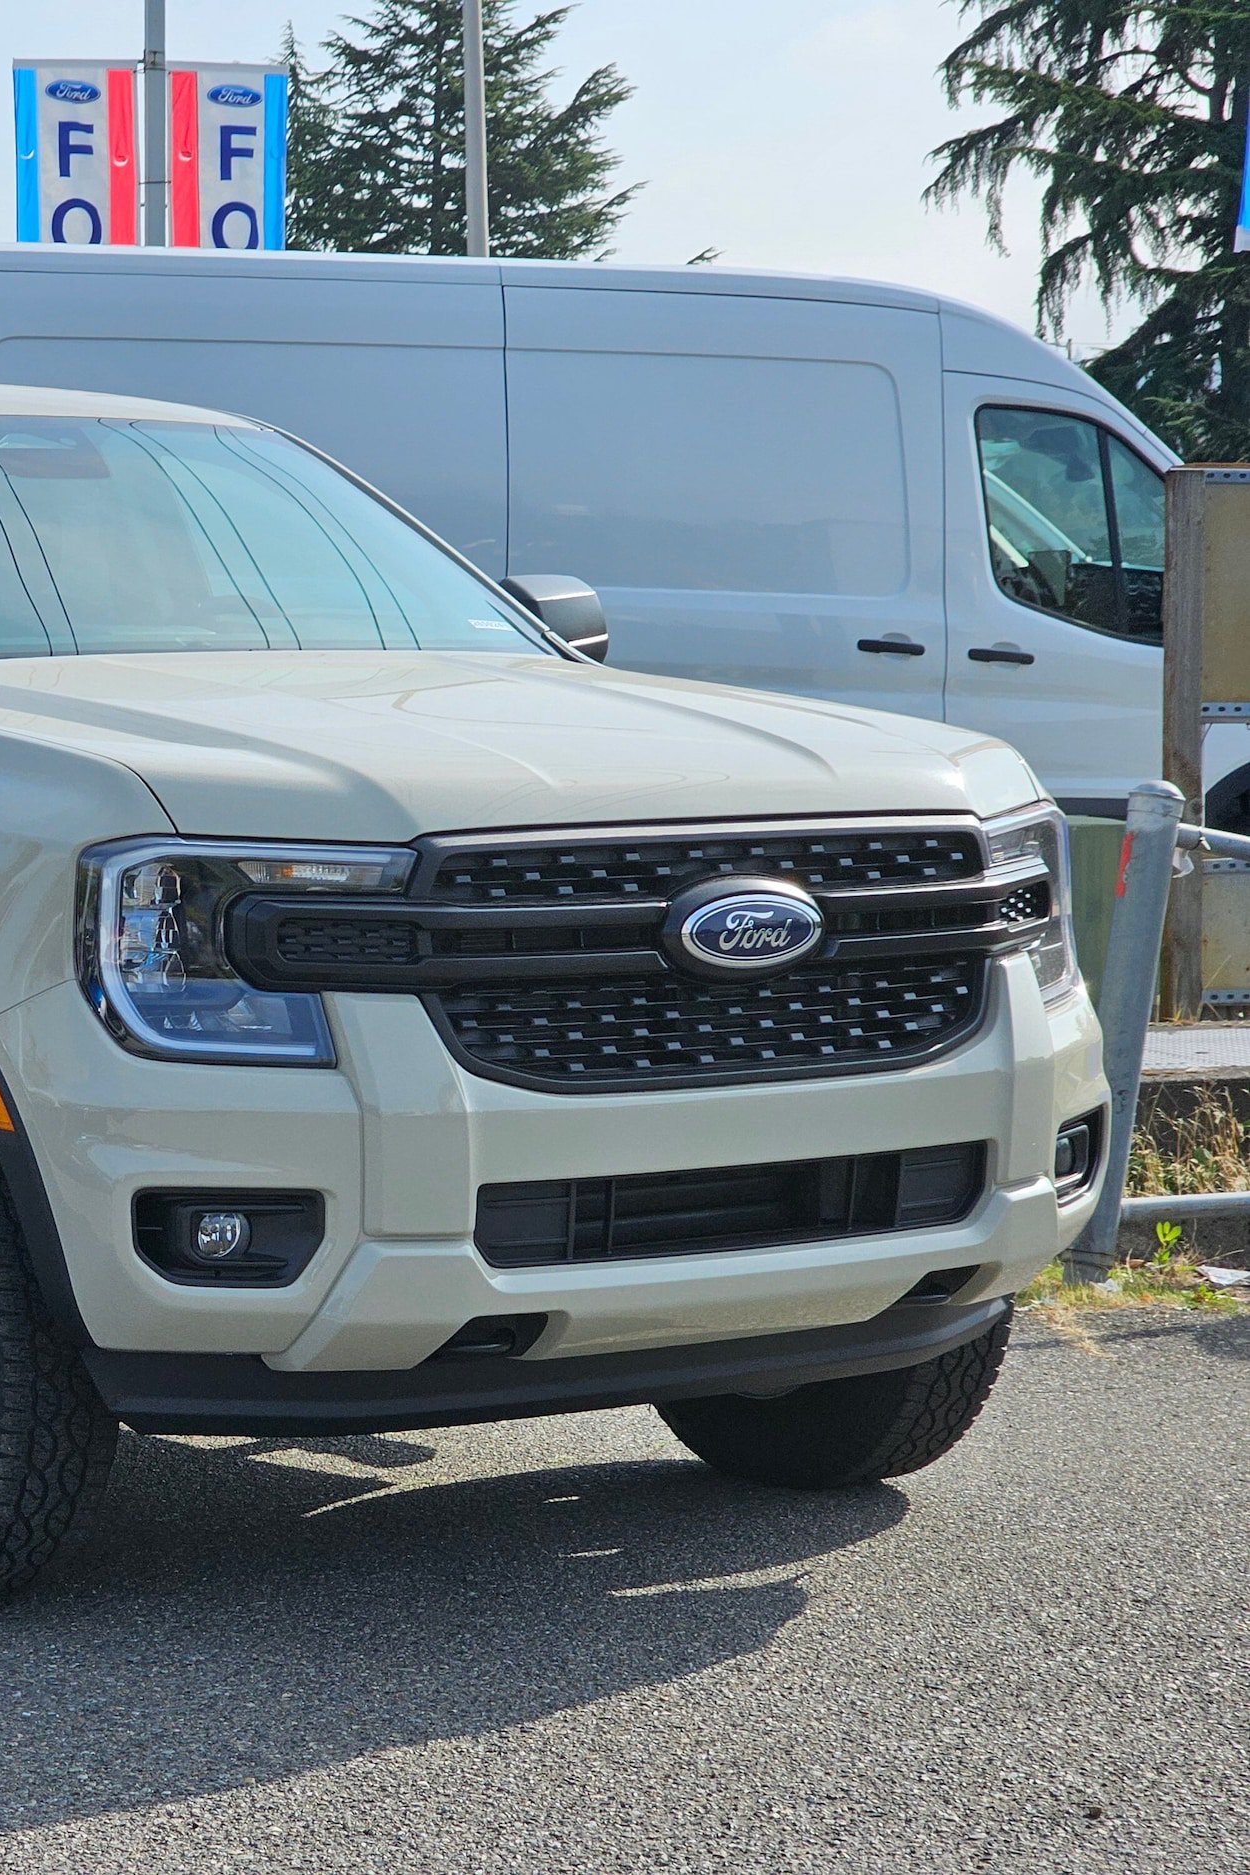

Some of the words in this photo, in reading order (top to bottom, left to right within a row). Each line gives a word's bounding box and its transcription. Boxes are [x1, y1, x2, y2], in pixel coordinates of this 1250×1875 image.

[56, 82, 91, 100] Ford
[217, 88, 253, 104] Ford
[719, 910, 793, 951] Ford
